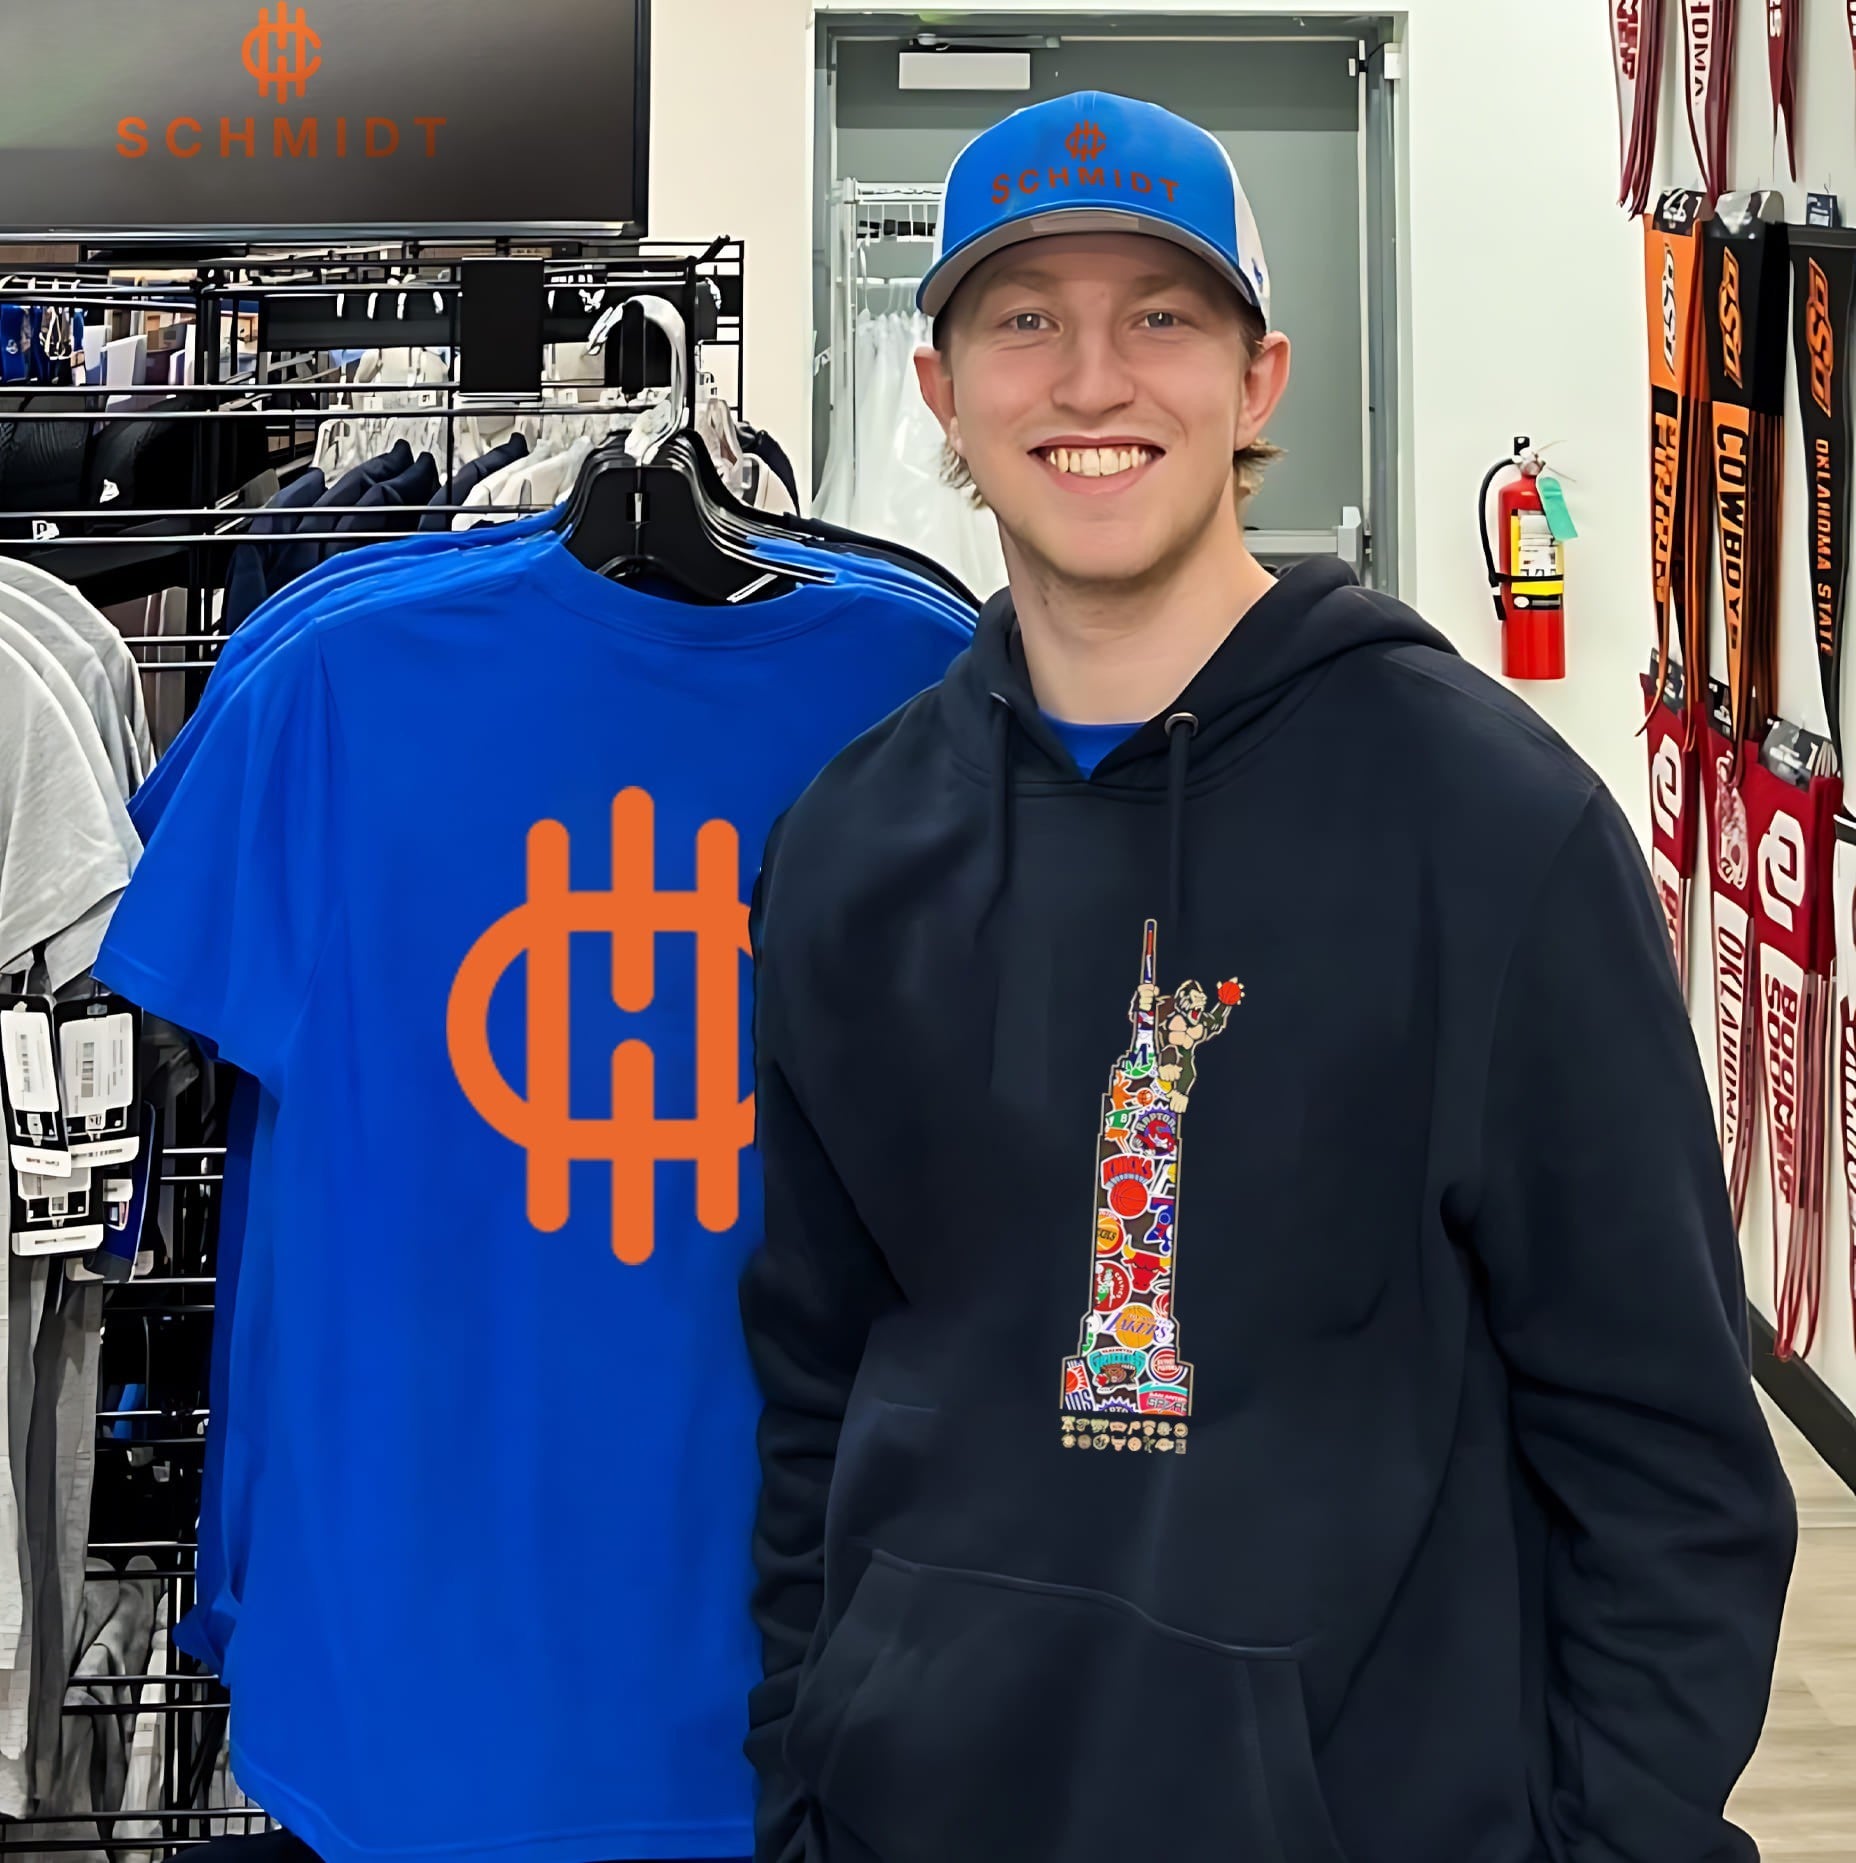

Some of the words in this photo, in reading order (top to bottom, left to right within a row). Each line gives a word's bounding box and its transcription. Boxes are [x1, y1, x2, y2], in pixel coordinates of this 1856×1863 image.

[115, 116, 448, 159] SCHMIDT
[991, 167, 1179, 205] SCHMIDT
[1718, 246, 1743, 389] OSU
[1806, 257, 1834, 418] OSU
[1815, 438, 1832, 570] OKLAHOMA
[1718, 926, 1744, 1144] OKLAHOMA
[1103, 1155, 1153, 1185] KNICKS
[1106, 1312, 1170, 1343] LAKERS
